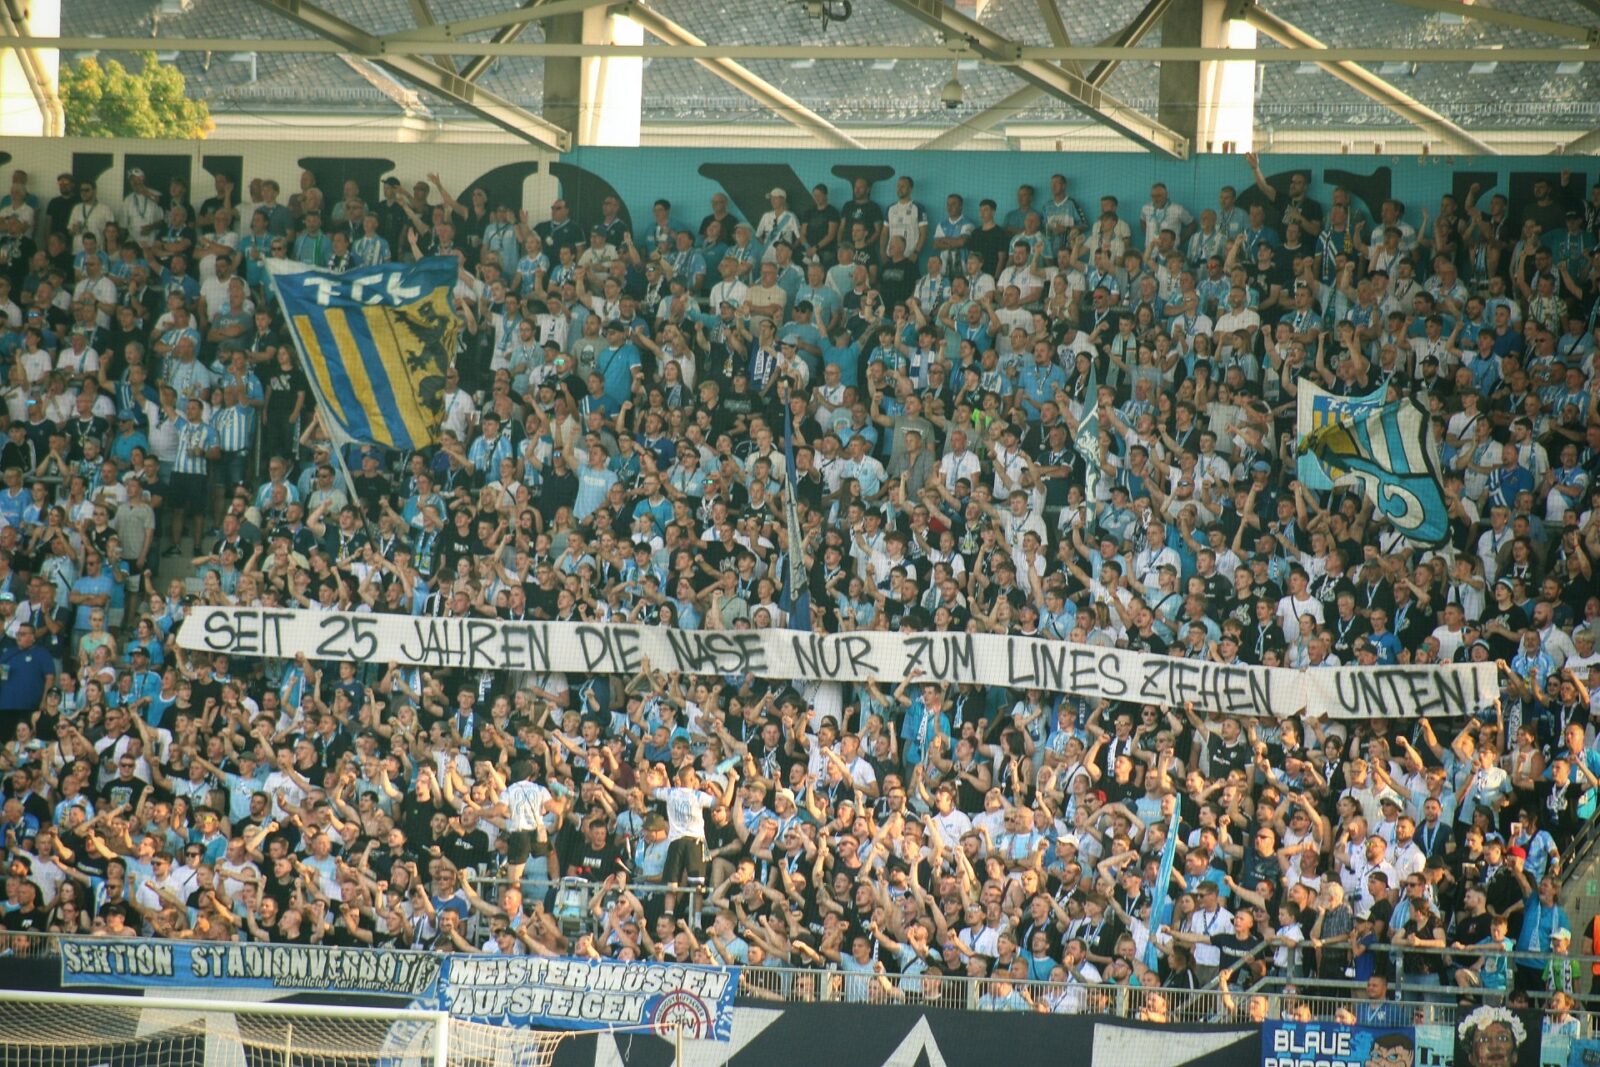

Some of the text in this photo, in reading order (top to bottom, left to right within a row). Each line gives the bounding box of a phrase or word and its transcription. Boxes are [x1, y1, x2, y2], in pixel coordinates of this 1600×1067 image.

[203, 610, 296, 656] SEIT
[316, 615, 378, 660] 25
[400, 618, 551, 671] JAHREN
[575, 625, 642, 671] DIE
[665, 629, 769, 673] NASE
[791, 634, 879, 678] NUR
[902, 633, 977, 681] ZUM
[1007, 637, 1129, 696] LINES
[1139, 659, 1272, 714] ZIEHEN
[1335, 666, 1481, 715] UNTEN!
[63, 942, 174, 977] SEKTION
[451, 957, 731, 1000] MEISTER MÜSSEN
[452, 987, 649, 1025] AUFSTEIGEN
[1274, 1029, 1351, 1056] BLAUE
